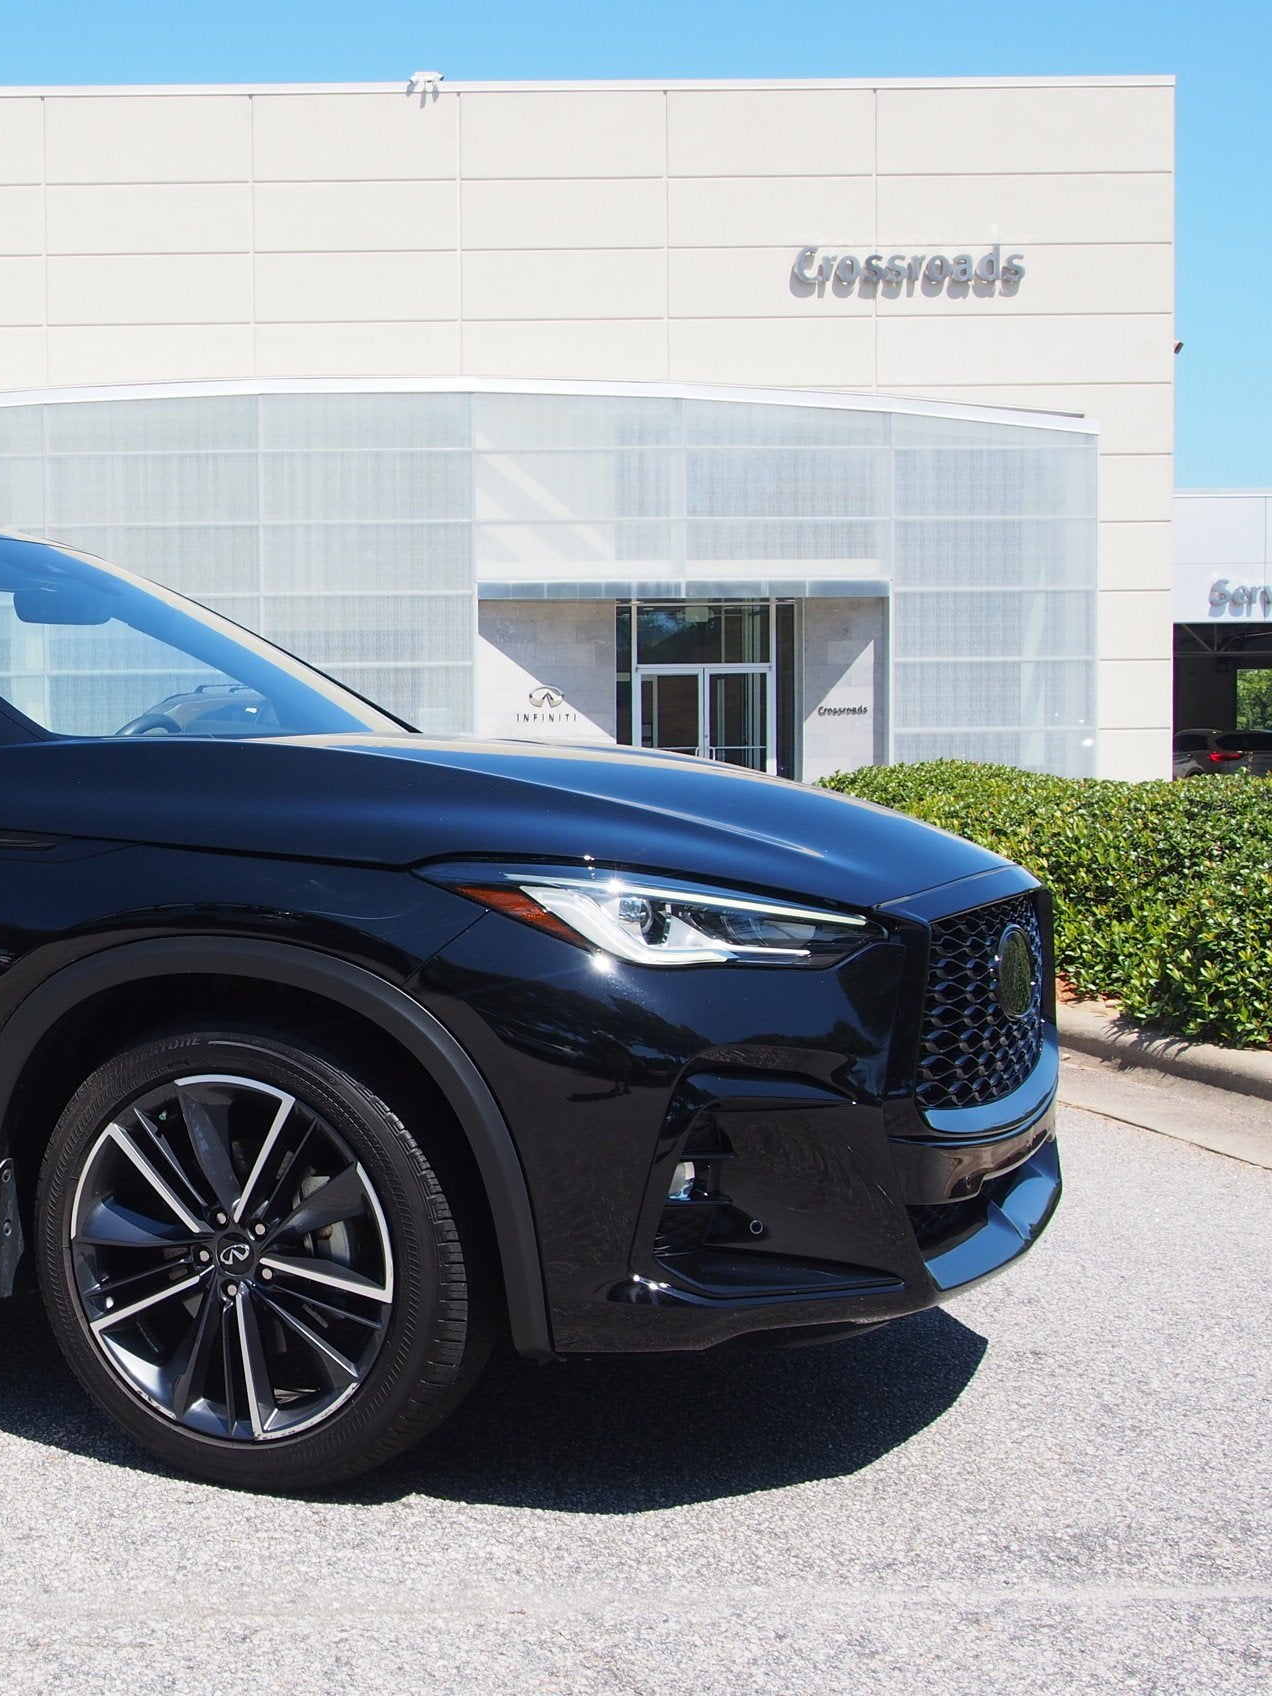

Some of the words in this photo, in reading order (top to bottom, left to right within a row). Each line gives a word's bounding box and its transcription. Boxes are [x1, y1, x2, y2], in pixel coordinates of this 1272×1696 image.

[794, 243, 1027, 284] Crossroads
[818, 704, 868, 716] Crossroads
[516, 713, 577, 722] INFINITI
